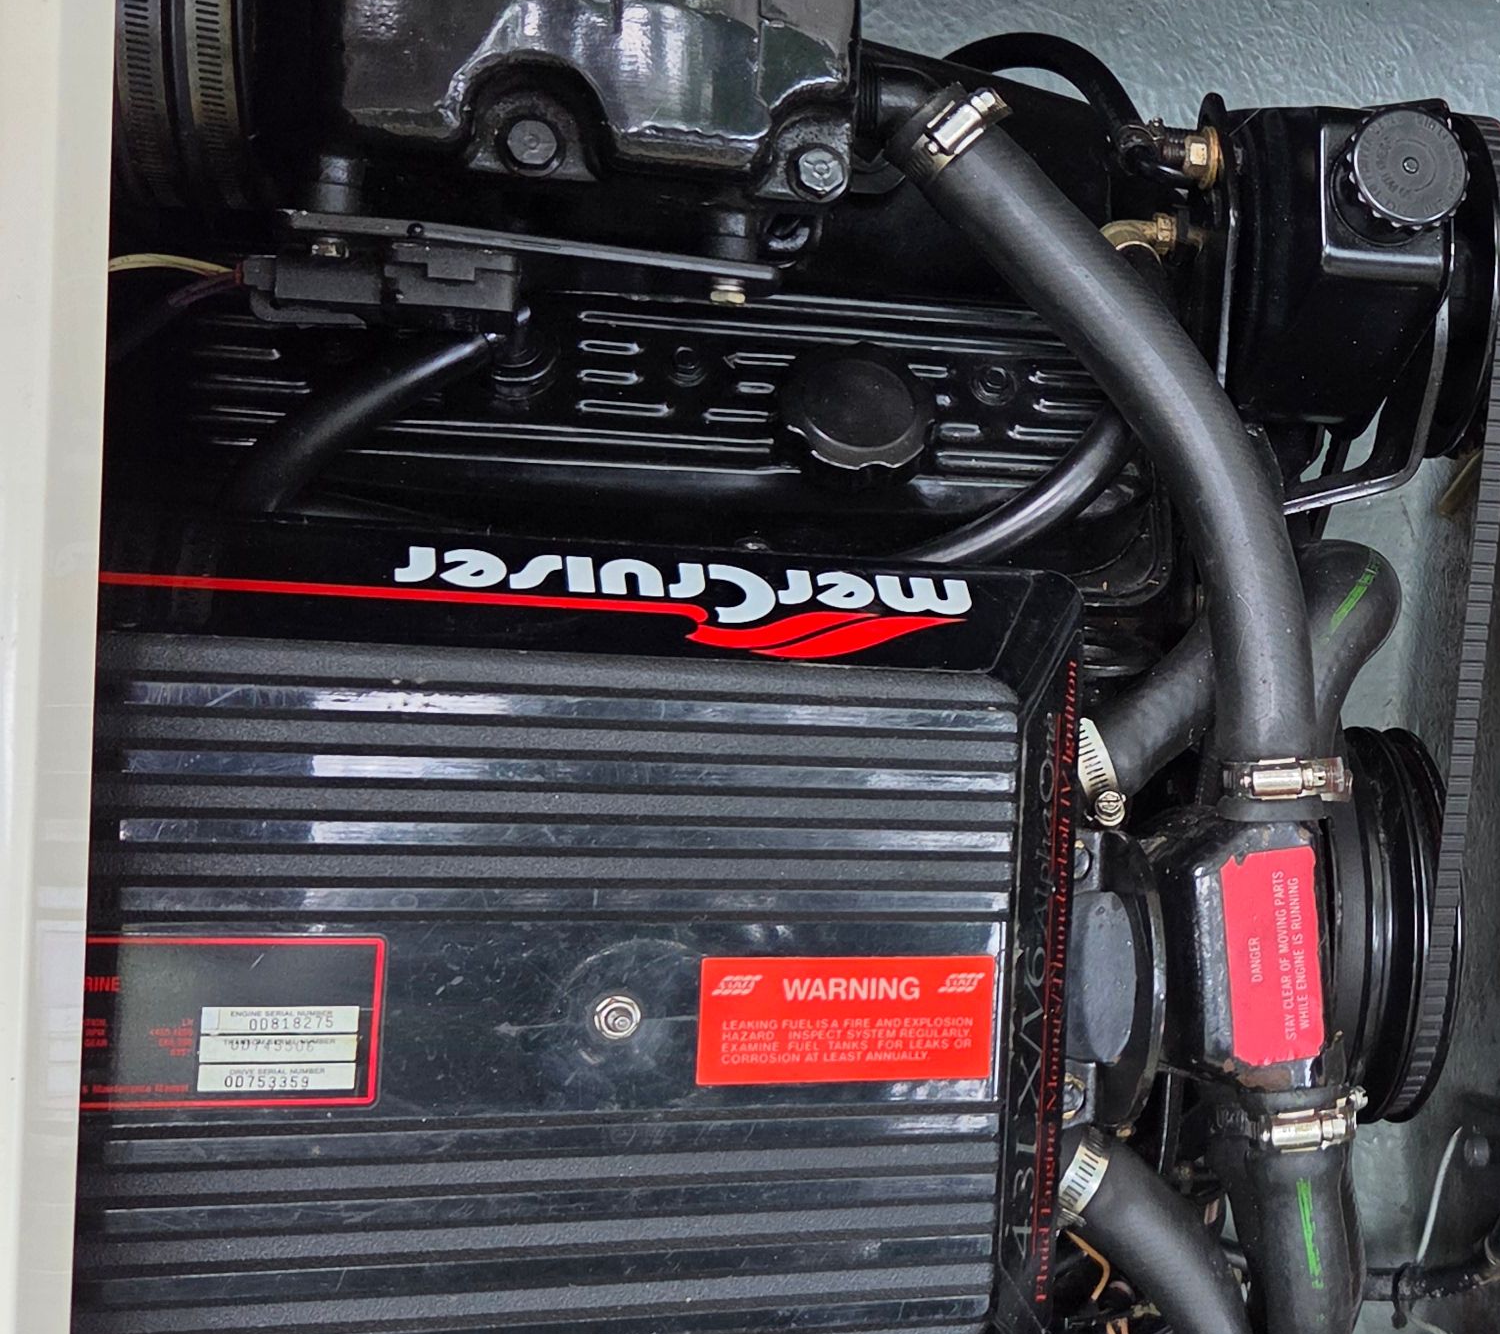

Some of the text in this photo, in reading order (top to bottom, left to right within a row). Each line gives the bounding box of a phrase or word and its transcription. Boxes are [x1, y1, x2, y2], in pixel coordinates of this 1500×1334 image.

[1248, 937, 1264, 983] DANGER
[1271, 870, 1297, 1040] STAY CLEAR OF MOVING PARTS
[1287, 877, 1311, 1029] WHILE ENGINE IS RUNNING
[783, 977, 921, 1001] WARNING
[722, 1017, 973, 1030] LEAKING FUEL IS A FIRE AND EXPLOSION
[722, 1031, 775, 1041] HAZARD
[788, 1030, 841, 1040] INSPECT
[847, 1029, 897, 1040] SYSTEM
[721, 1038, 972, 1052] EXAMINE FUEL TANKS FOR LEAKS OR
[721, 1052, 800, 1064] CORROSION
[804, 1052, 819, 1063] AT
[823, 1052, 862, 1063] LEAST
